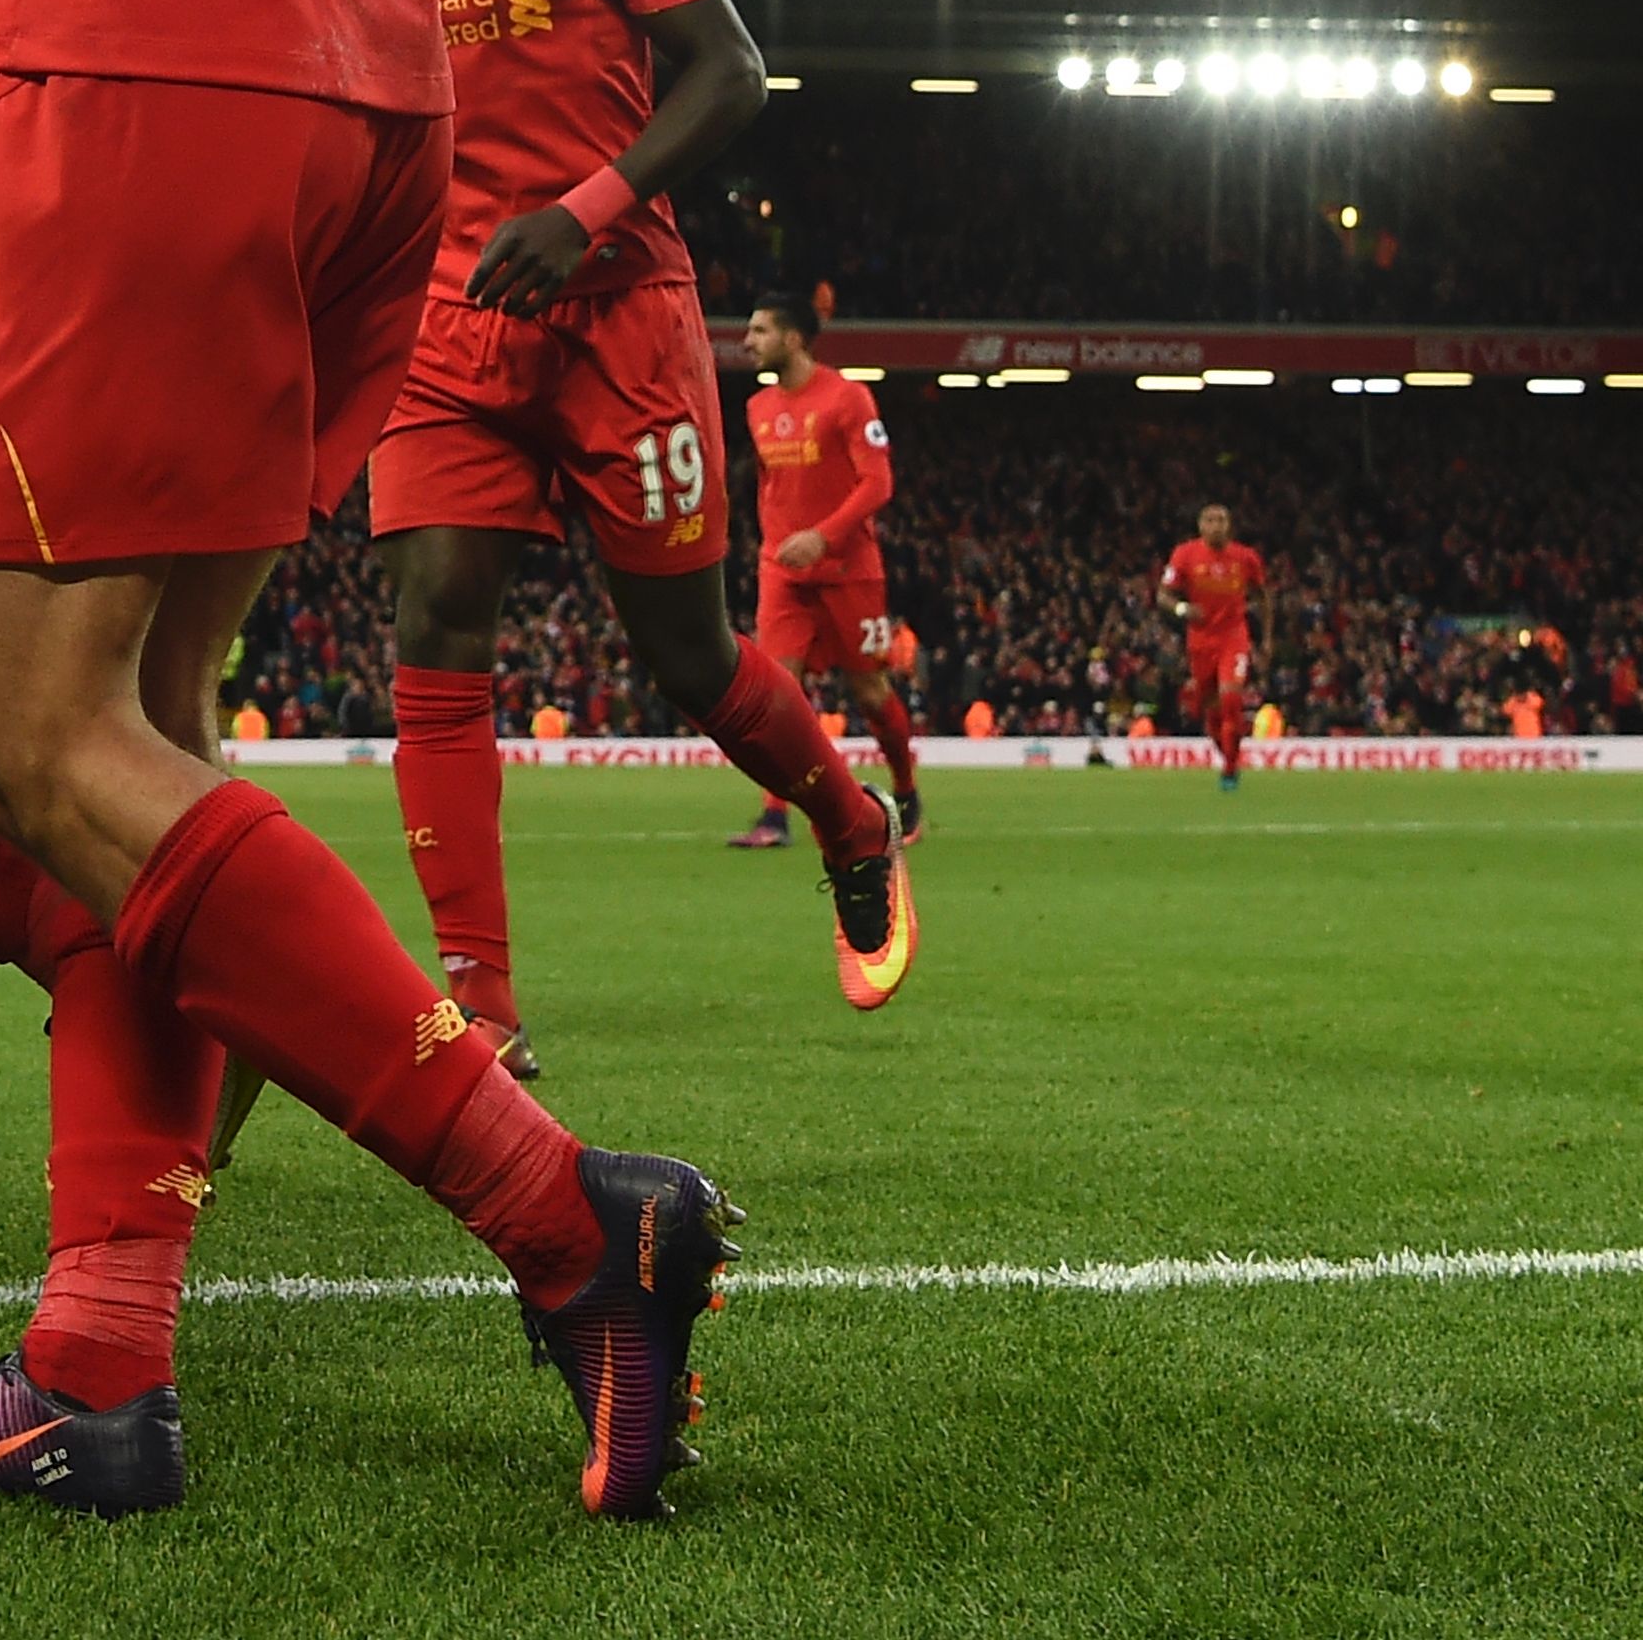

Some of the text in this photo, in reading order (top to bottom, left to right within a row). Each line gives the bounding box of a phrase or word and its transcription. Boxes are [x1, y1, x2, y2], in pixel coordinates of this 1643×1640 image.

[1080, 337, 1203, 366] balance
[633, 422, 704, 523] 19
[860, 616, 890, 655] 23
[1128, 747, 1213, 768] WIN
